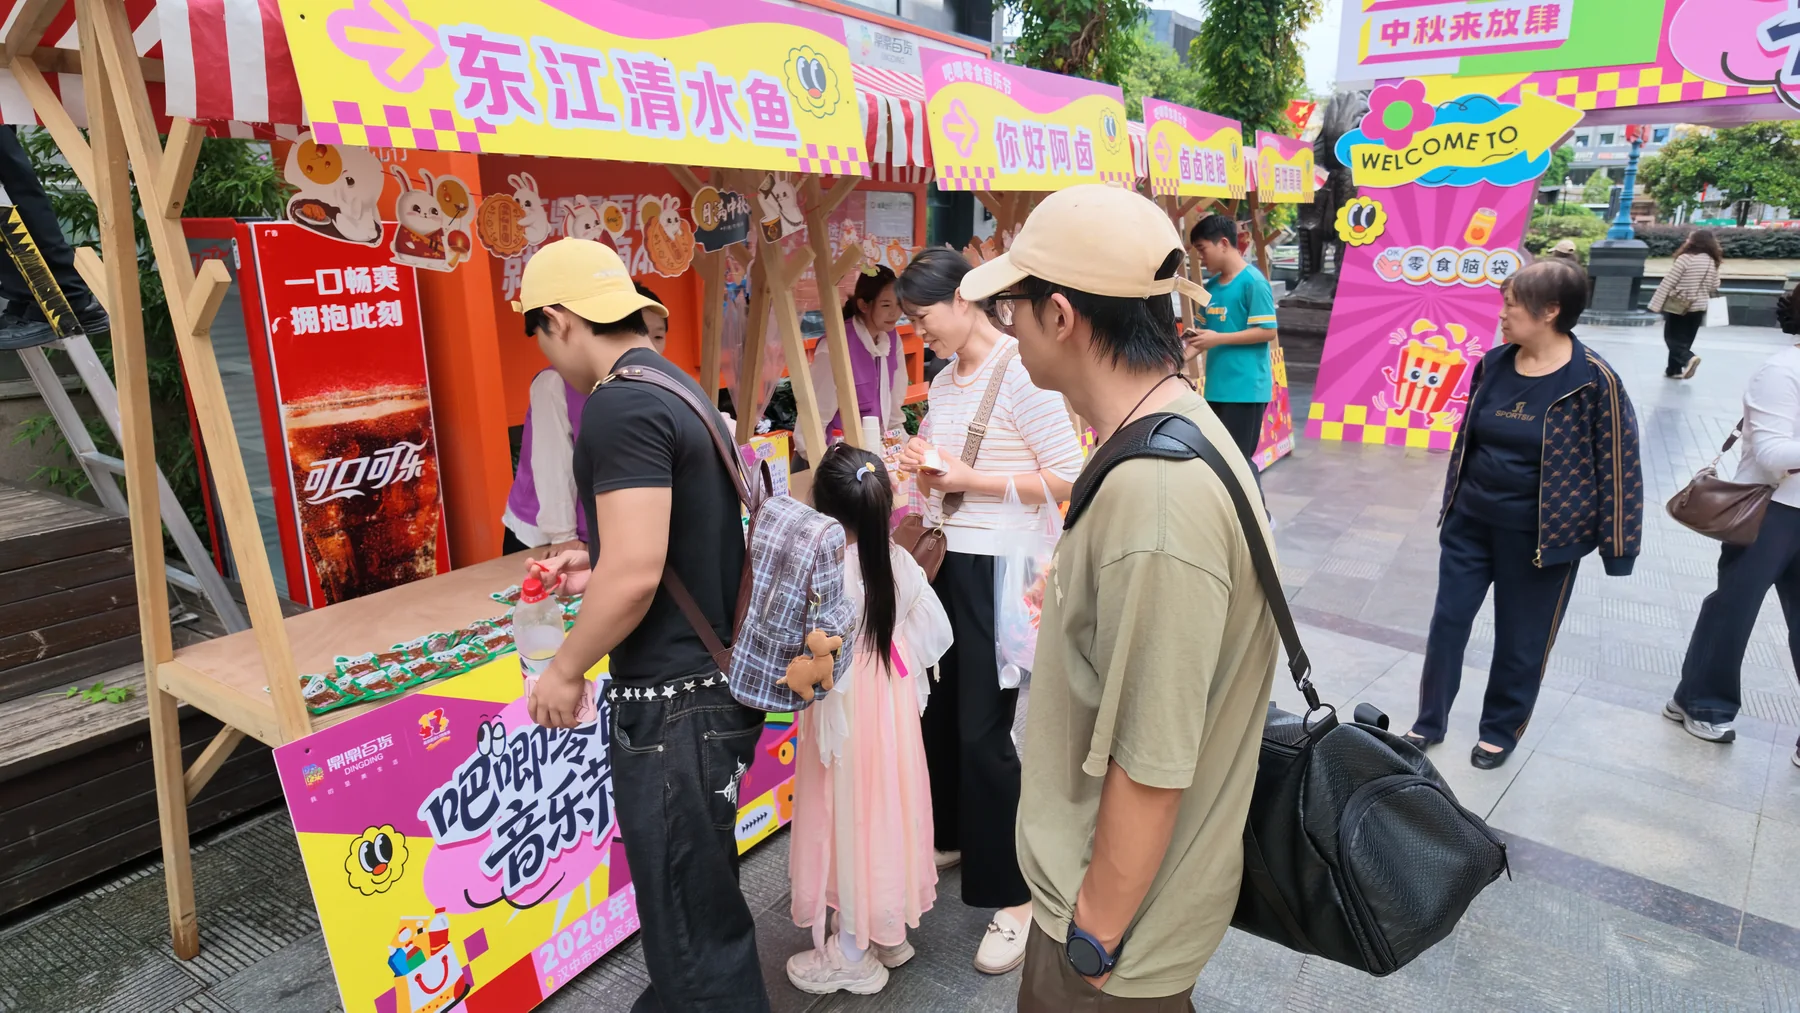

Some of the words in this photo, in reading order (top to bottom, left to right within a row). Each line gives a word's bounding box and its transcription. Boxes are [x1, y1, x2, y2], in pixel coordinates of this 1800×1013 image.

[1380, 4, 1561, 47] 中秋来放肆
[447, 32, 799, 142] 东江清水鱼
[995, 121, 1094, 172] 你好阿卤
[1361, 131, 1479, 171] WELCOME
[1485, 125, 1518, 150] TO
[1386, 249, 1400, 257] OK
[1407, 256, 1509, 276] 零食脑袋
[284, 265, 400, 296] 一口畅爽
[289, 299, 404, 336] 拥抱此刻
[303, 438, 428, 505] 可口可乐
[327, 734, 394, 773] 鼎鼎百货
[344, 753, 385, 776] DINGDING
